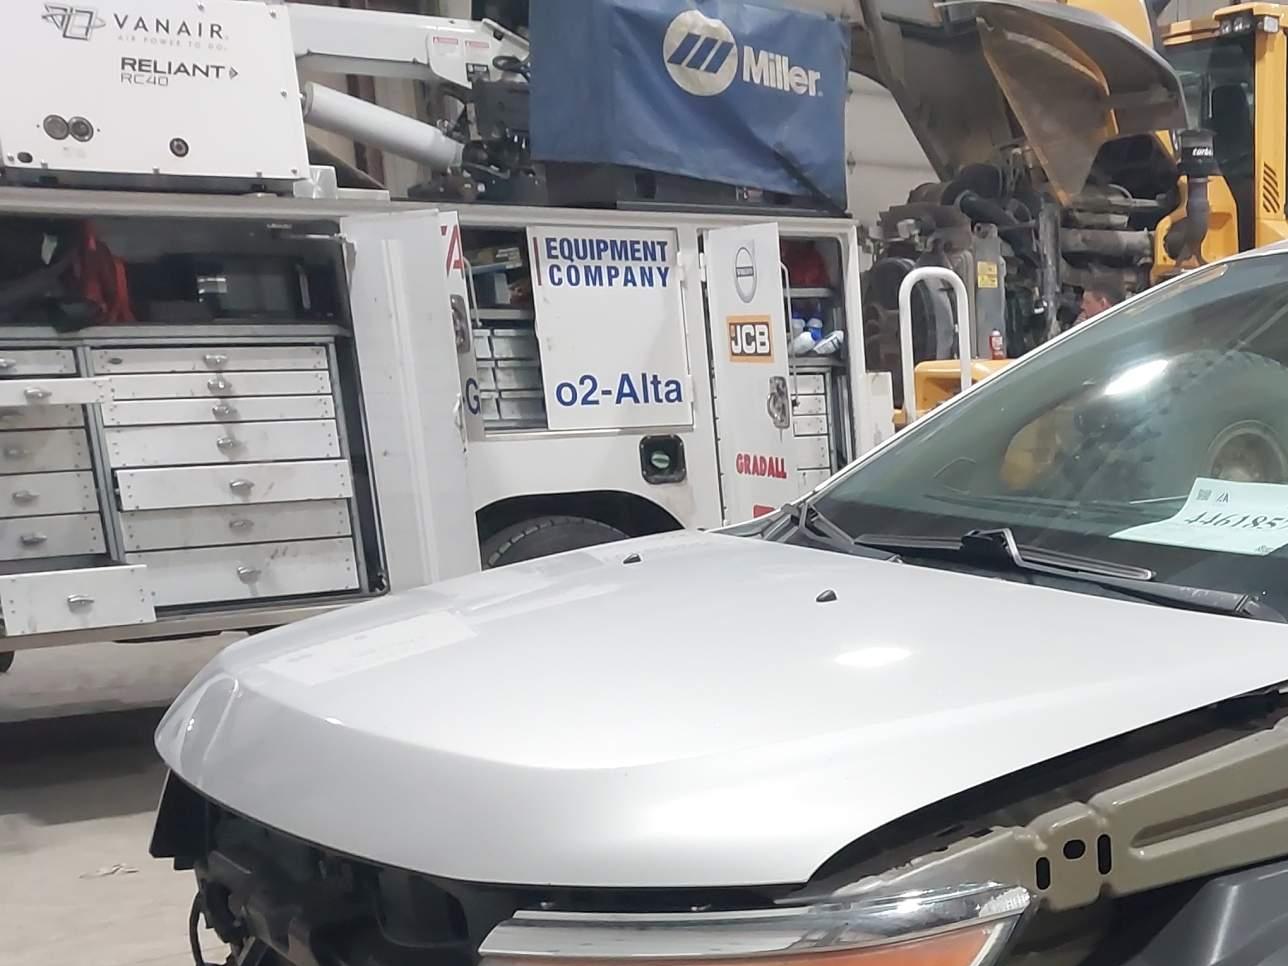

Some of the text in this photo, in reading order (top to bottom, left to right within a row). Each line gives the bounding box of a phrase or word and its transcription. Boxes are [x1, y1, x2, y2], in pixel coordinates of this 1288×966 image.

[113, 13, 223, 39] VANAIR
[121, 57, 225, 79] RELIANT
[121, 73, 169, 87] RC40
[743, 45, 820, 96] Miller
[545, 237, 668, 262] EQUIPMENT
[549, 264, 669, 287] COMPANY
[730, 324, 770, 354] JCB
[555, 373, 683, 406] o2-Alta
[736, 453, 787, 479] GRADALL
